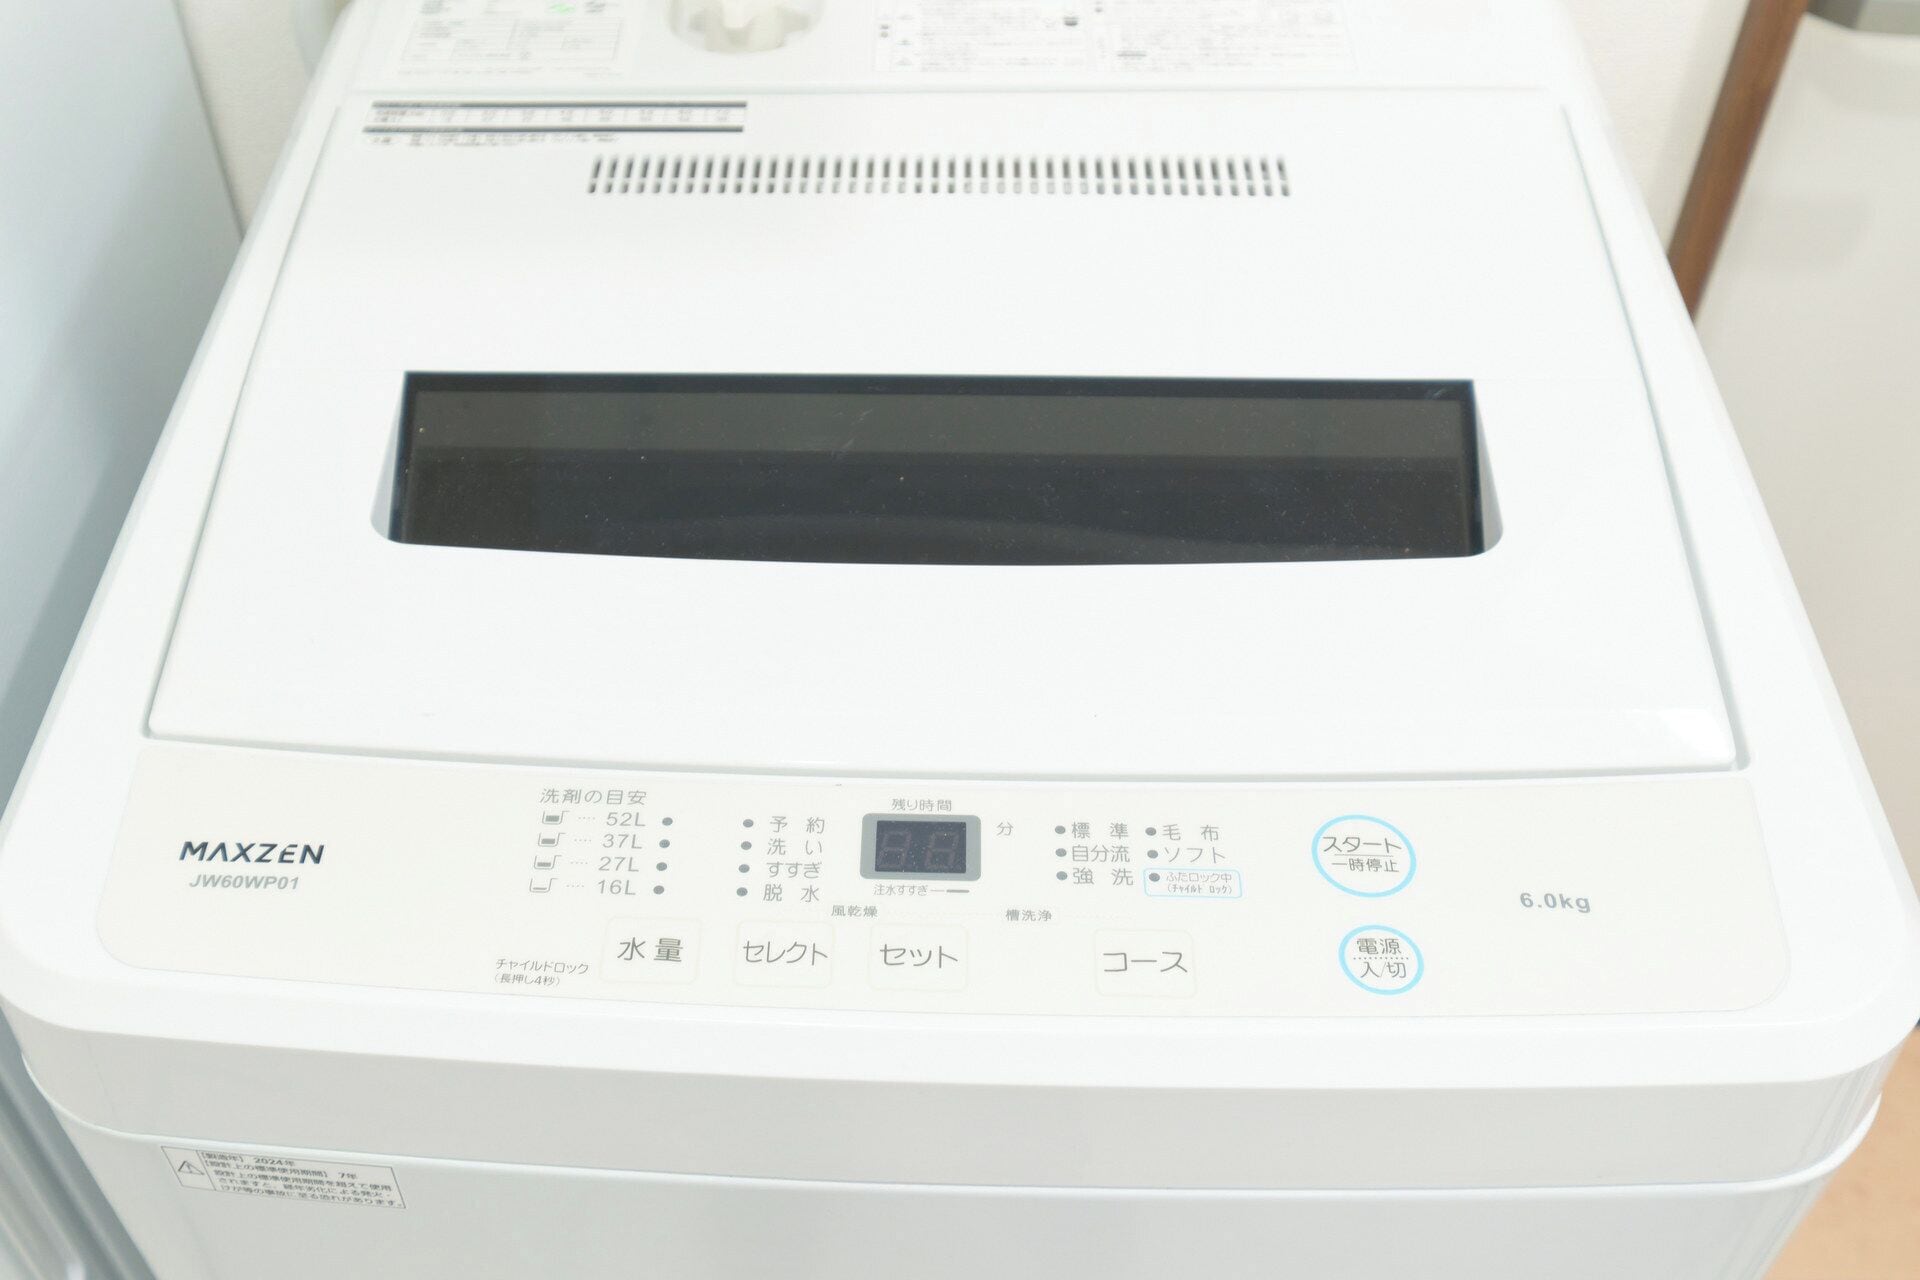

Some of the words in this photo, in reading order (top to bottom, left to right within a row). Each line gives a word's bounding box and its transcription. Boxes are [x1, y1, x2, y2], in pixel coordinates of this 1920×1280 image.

[540, 788, 647, 805] 洗剤の目安
[891, 798, 953, 812] 残り時間
[606, 812, 646, 827] 52L
[996, 822, 1014, 837] 分
[602, 833, 643, 849] 37L
[1322, 837, 1402, 854] スタート
[179, 841, 325, 864] MAXZEN
[1072, 845, 1131, 863] 自分流
[1165, 847, 1226, 864] ソフト
[598, 856, 640, 872] 27L
[766, 861, 822, 879] すすぎ
[1331, 858, 1400, 873] 一時停止
[189, 874, 299, 890] JW60WP01
[1166, 872, 1232, 883] ふたロック中
[598, 879, 636, 895] 16L
[874, 884, 928, 896] 注水すすぎ
[1519, 892, 1591, 913] 6.0kg
[831, 905, 878, 918] 風乾燥
[1005, 909, 1052, 922] 槽洗浄
[617, 937, 684, 962] 水量
[743, 941, 828, 965] セレクト
[1357, 938, 1402, 955] 電源
[879, 943, 958, 968] セット
[1103, 951, 1188, 972] コース
[496, 959, 589, 974] チャイルドロック
